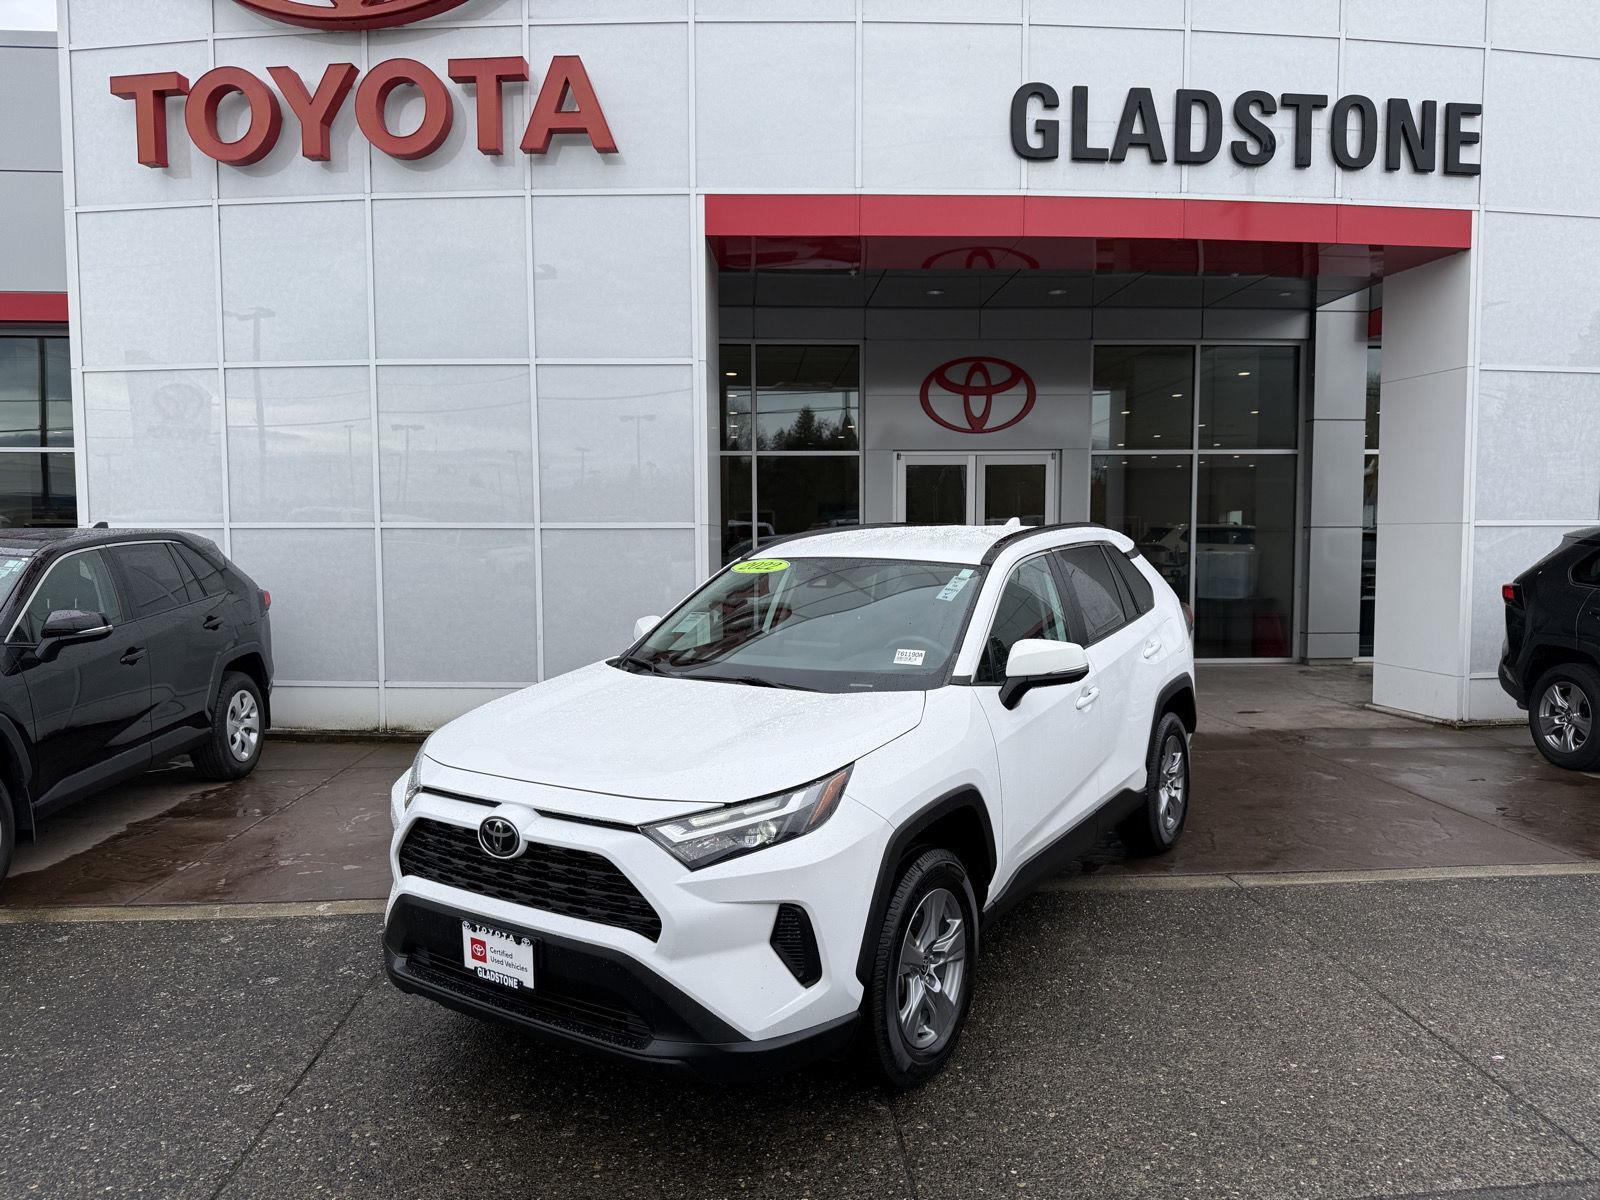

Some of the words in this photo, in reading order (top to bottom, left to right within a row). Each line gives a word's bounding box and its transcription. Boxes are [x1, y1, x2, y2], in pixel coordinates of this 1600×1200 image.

[110, 55, 619, 169] TOYOTA
[1010, 82, 1482, 177] GLADSTONE
[475, 924, 515, 941] TOYOTA
[489, 946, 513, 959] Certified
[490, 956, 504, 965] Used
[504, 960, 528, 972] Vehicles
[477, 967, 519, 989] GLADSTONE
